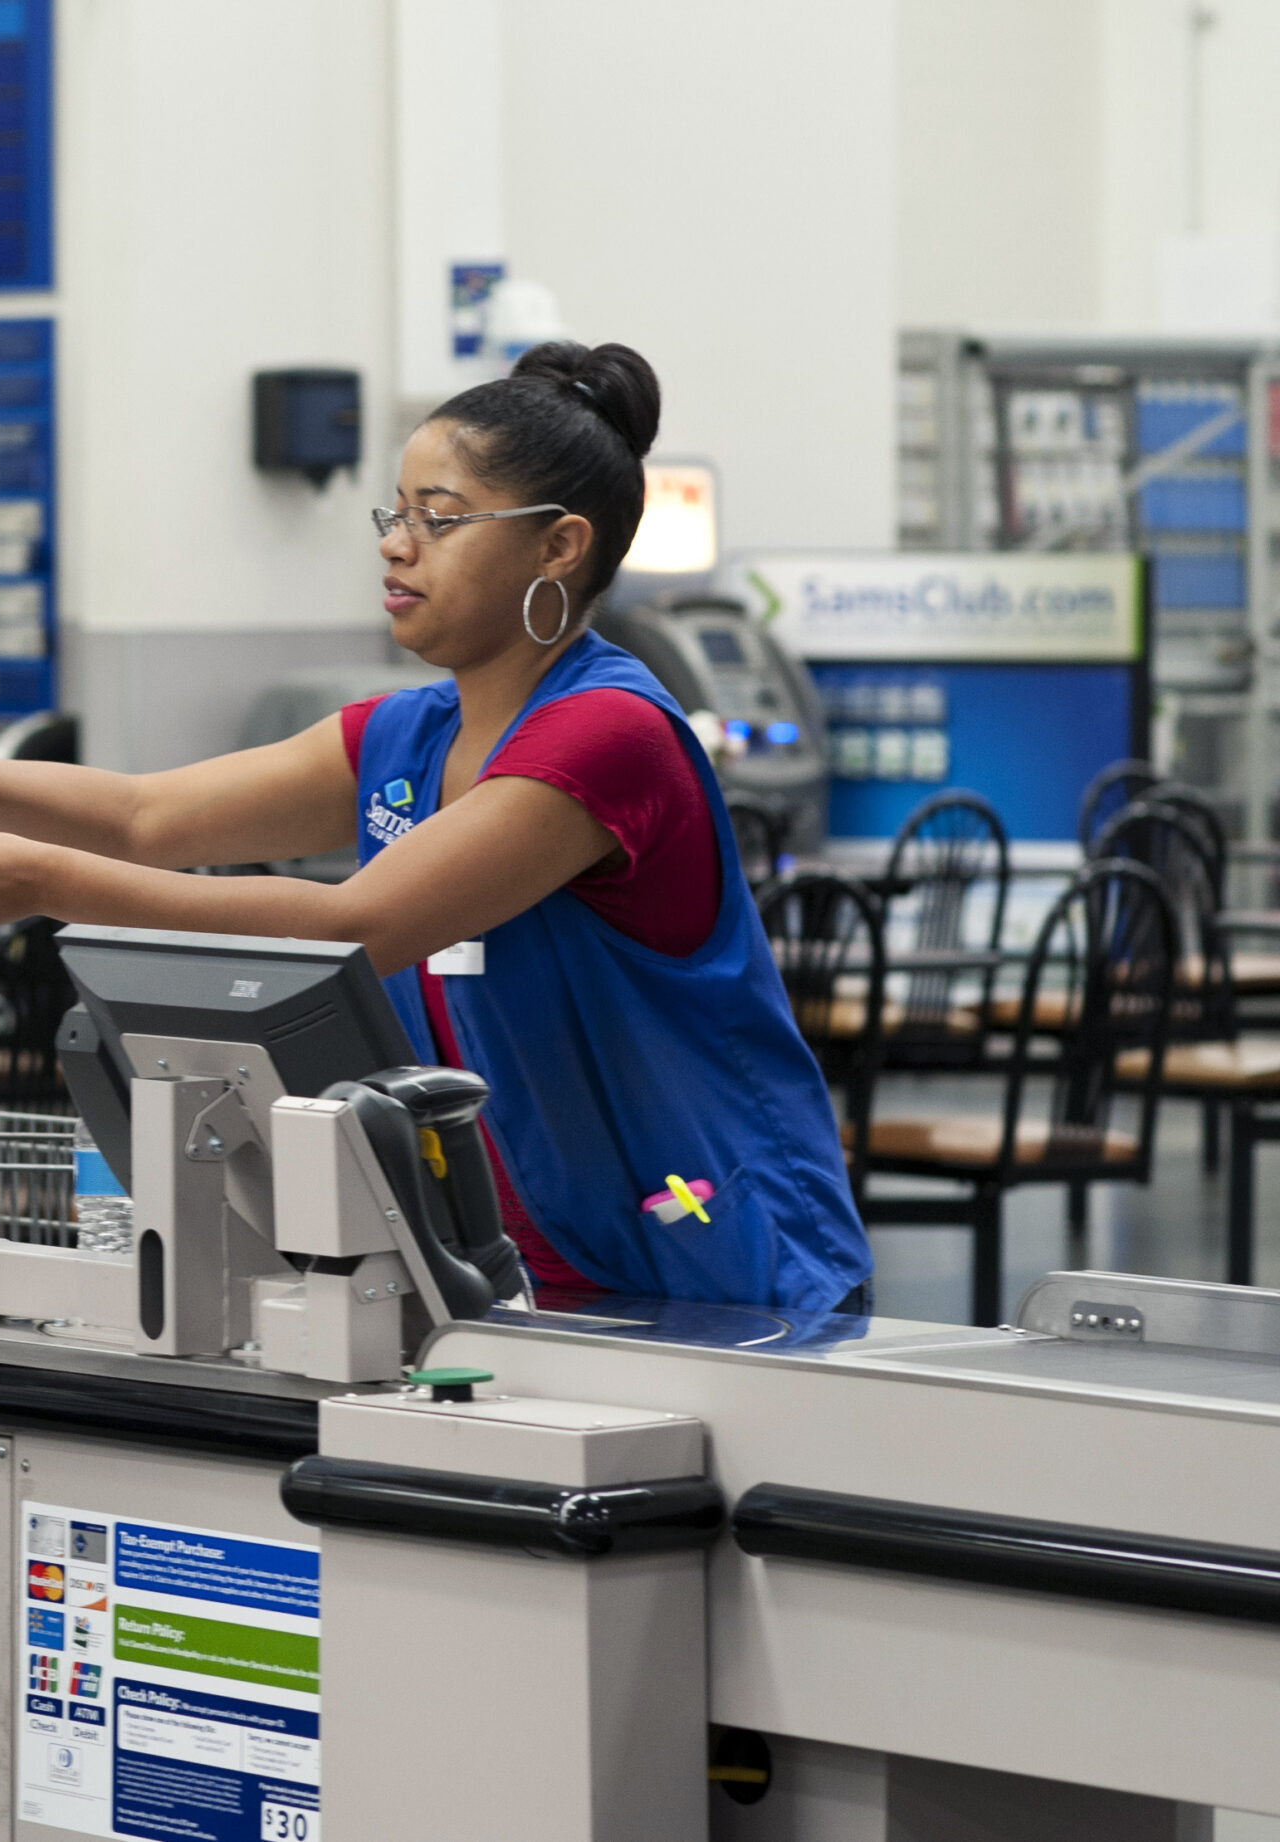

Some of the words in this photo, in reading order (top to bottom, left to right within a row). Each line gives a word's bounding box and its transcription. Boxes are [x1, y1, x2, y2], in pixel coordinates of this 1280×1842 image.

[802, 572, 1114, 622] SamsClub.com
[228, 980, 263, 998] IBM
[119, 1531, 176, 1553] Tax-Exempt
[117, 1617, 151, 1635] Return
[151, 1621, 186, 1642] Policy:
[31, 1698, 56, 1714] Cash
[117, 1685, 147, 1703] Check
[148, 1689, 181, 1711] Policy:
[73, 1706, 100, 1722] ATM
[30, 1718, 58, 1734] Check
[73, 1726, 100, 1741] Debit
